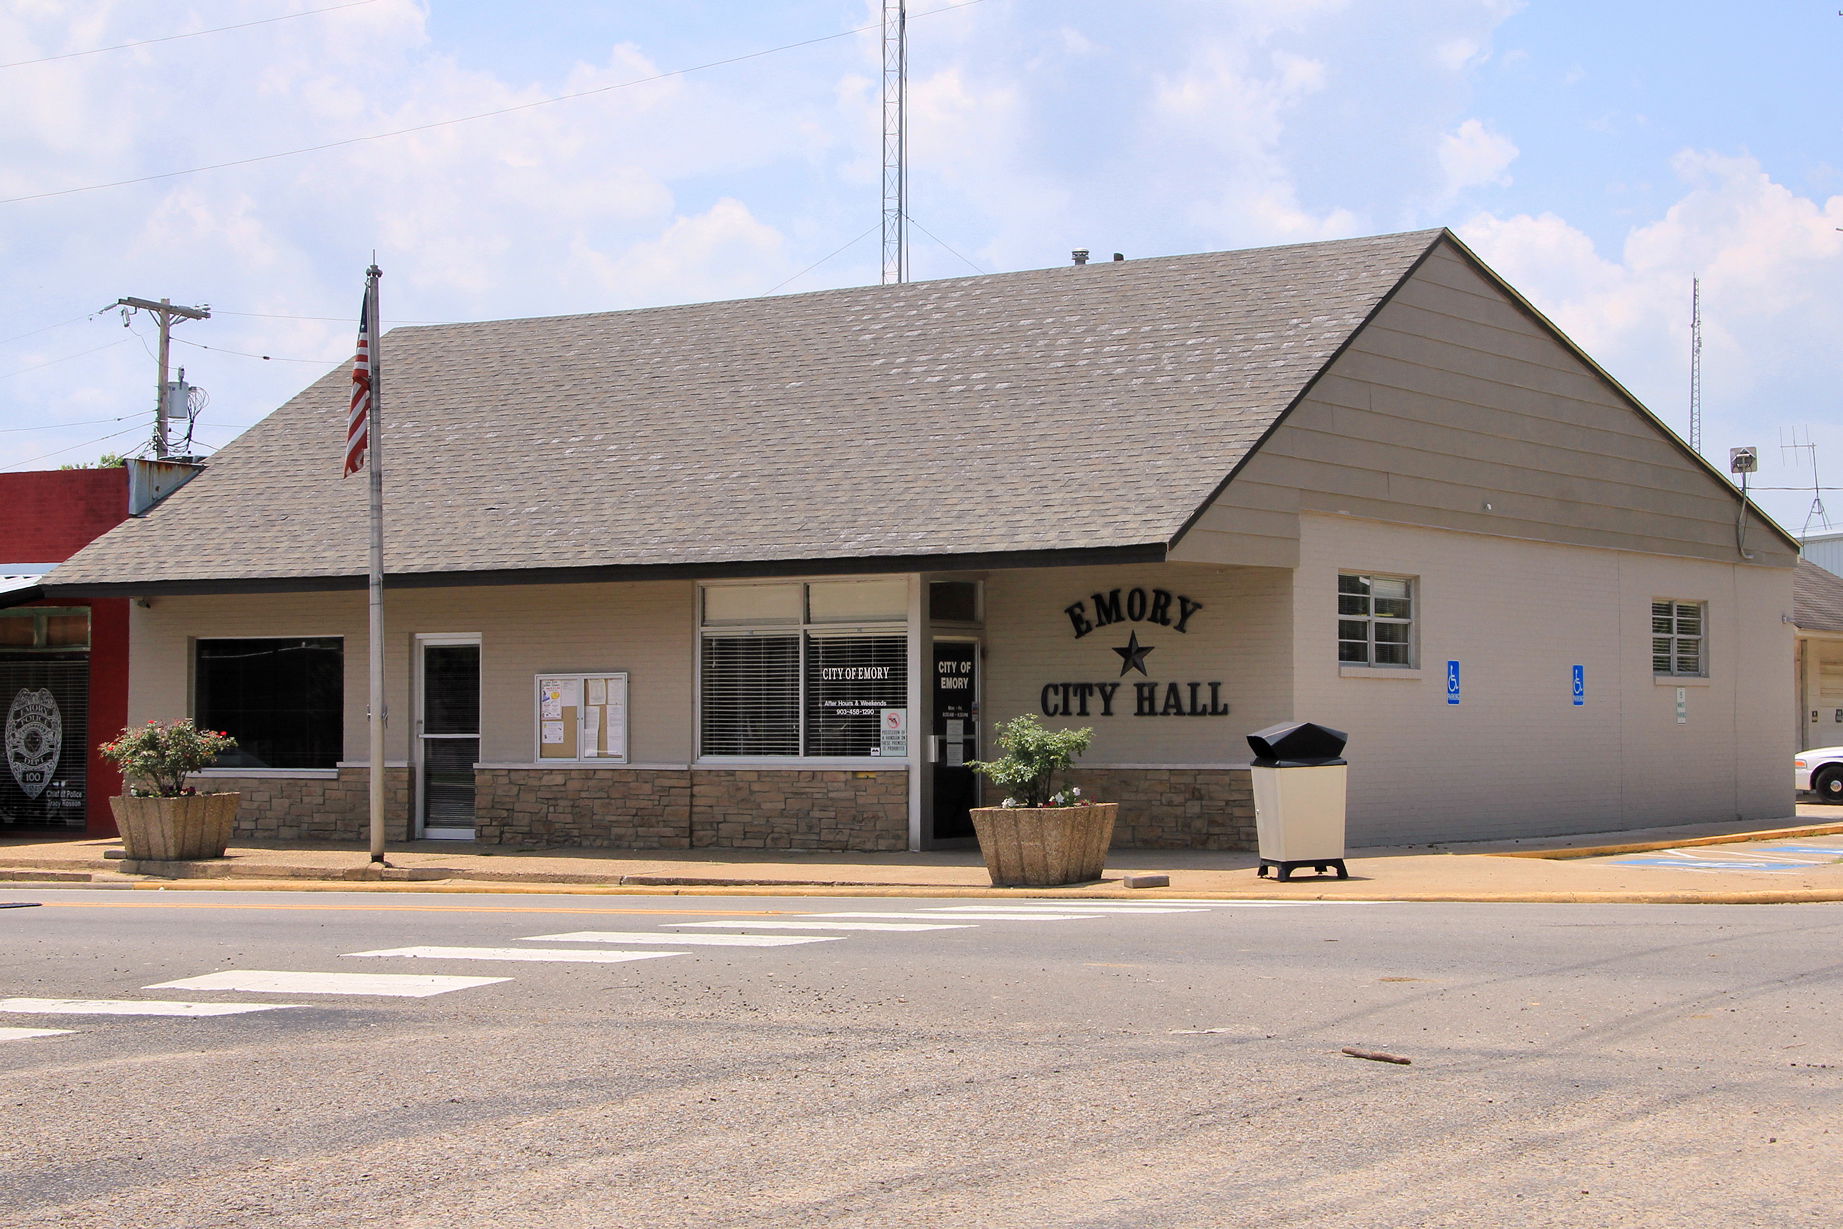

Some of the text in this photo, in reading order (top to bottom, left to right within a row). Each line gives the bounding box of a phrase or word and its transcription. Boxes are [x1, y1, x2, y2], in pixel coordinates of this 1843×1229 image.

[1064, 587, 1203, 639] EMORY
[822, 666, 890, 680] CITY OF EMORY
[938, 661, 972, 673] CITY OF
[940, 677, 969, 689] EMORY
[1041, 682, 1229, 717] CITY HALL
[26, 772, 41, 782] 100
[66, 790, 82, 798] Police
